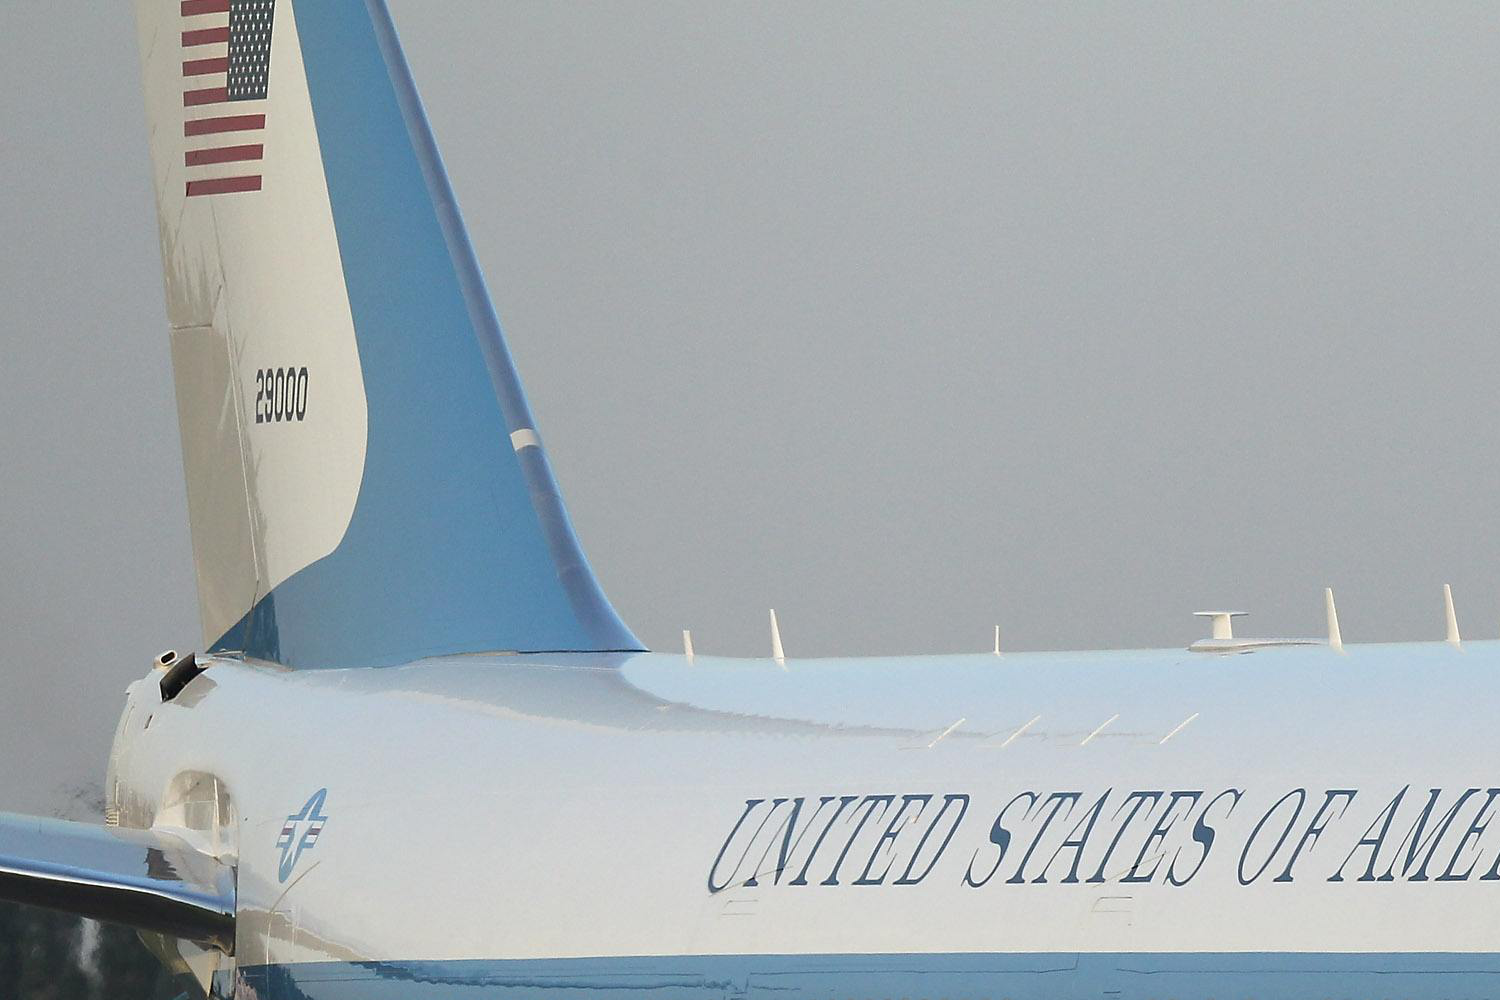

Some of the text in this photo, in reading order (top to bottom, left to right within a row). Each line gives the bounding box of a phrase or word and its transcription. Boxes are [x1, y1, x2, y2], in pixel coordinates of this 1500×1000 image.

[255, 366, 309, 424] 29000
[707, 793, 971, 894] UNITED
[960, 787, 1246, 888] STATES
[1237, 787, 1359, 886] OF
